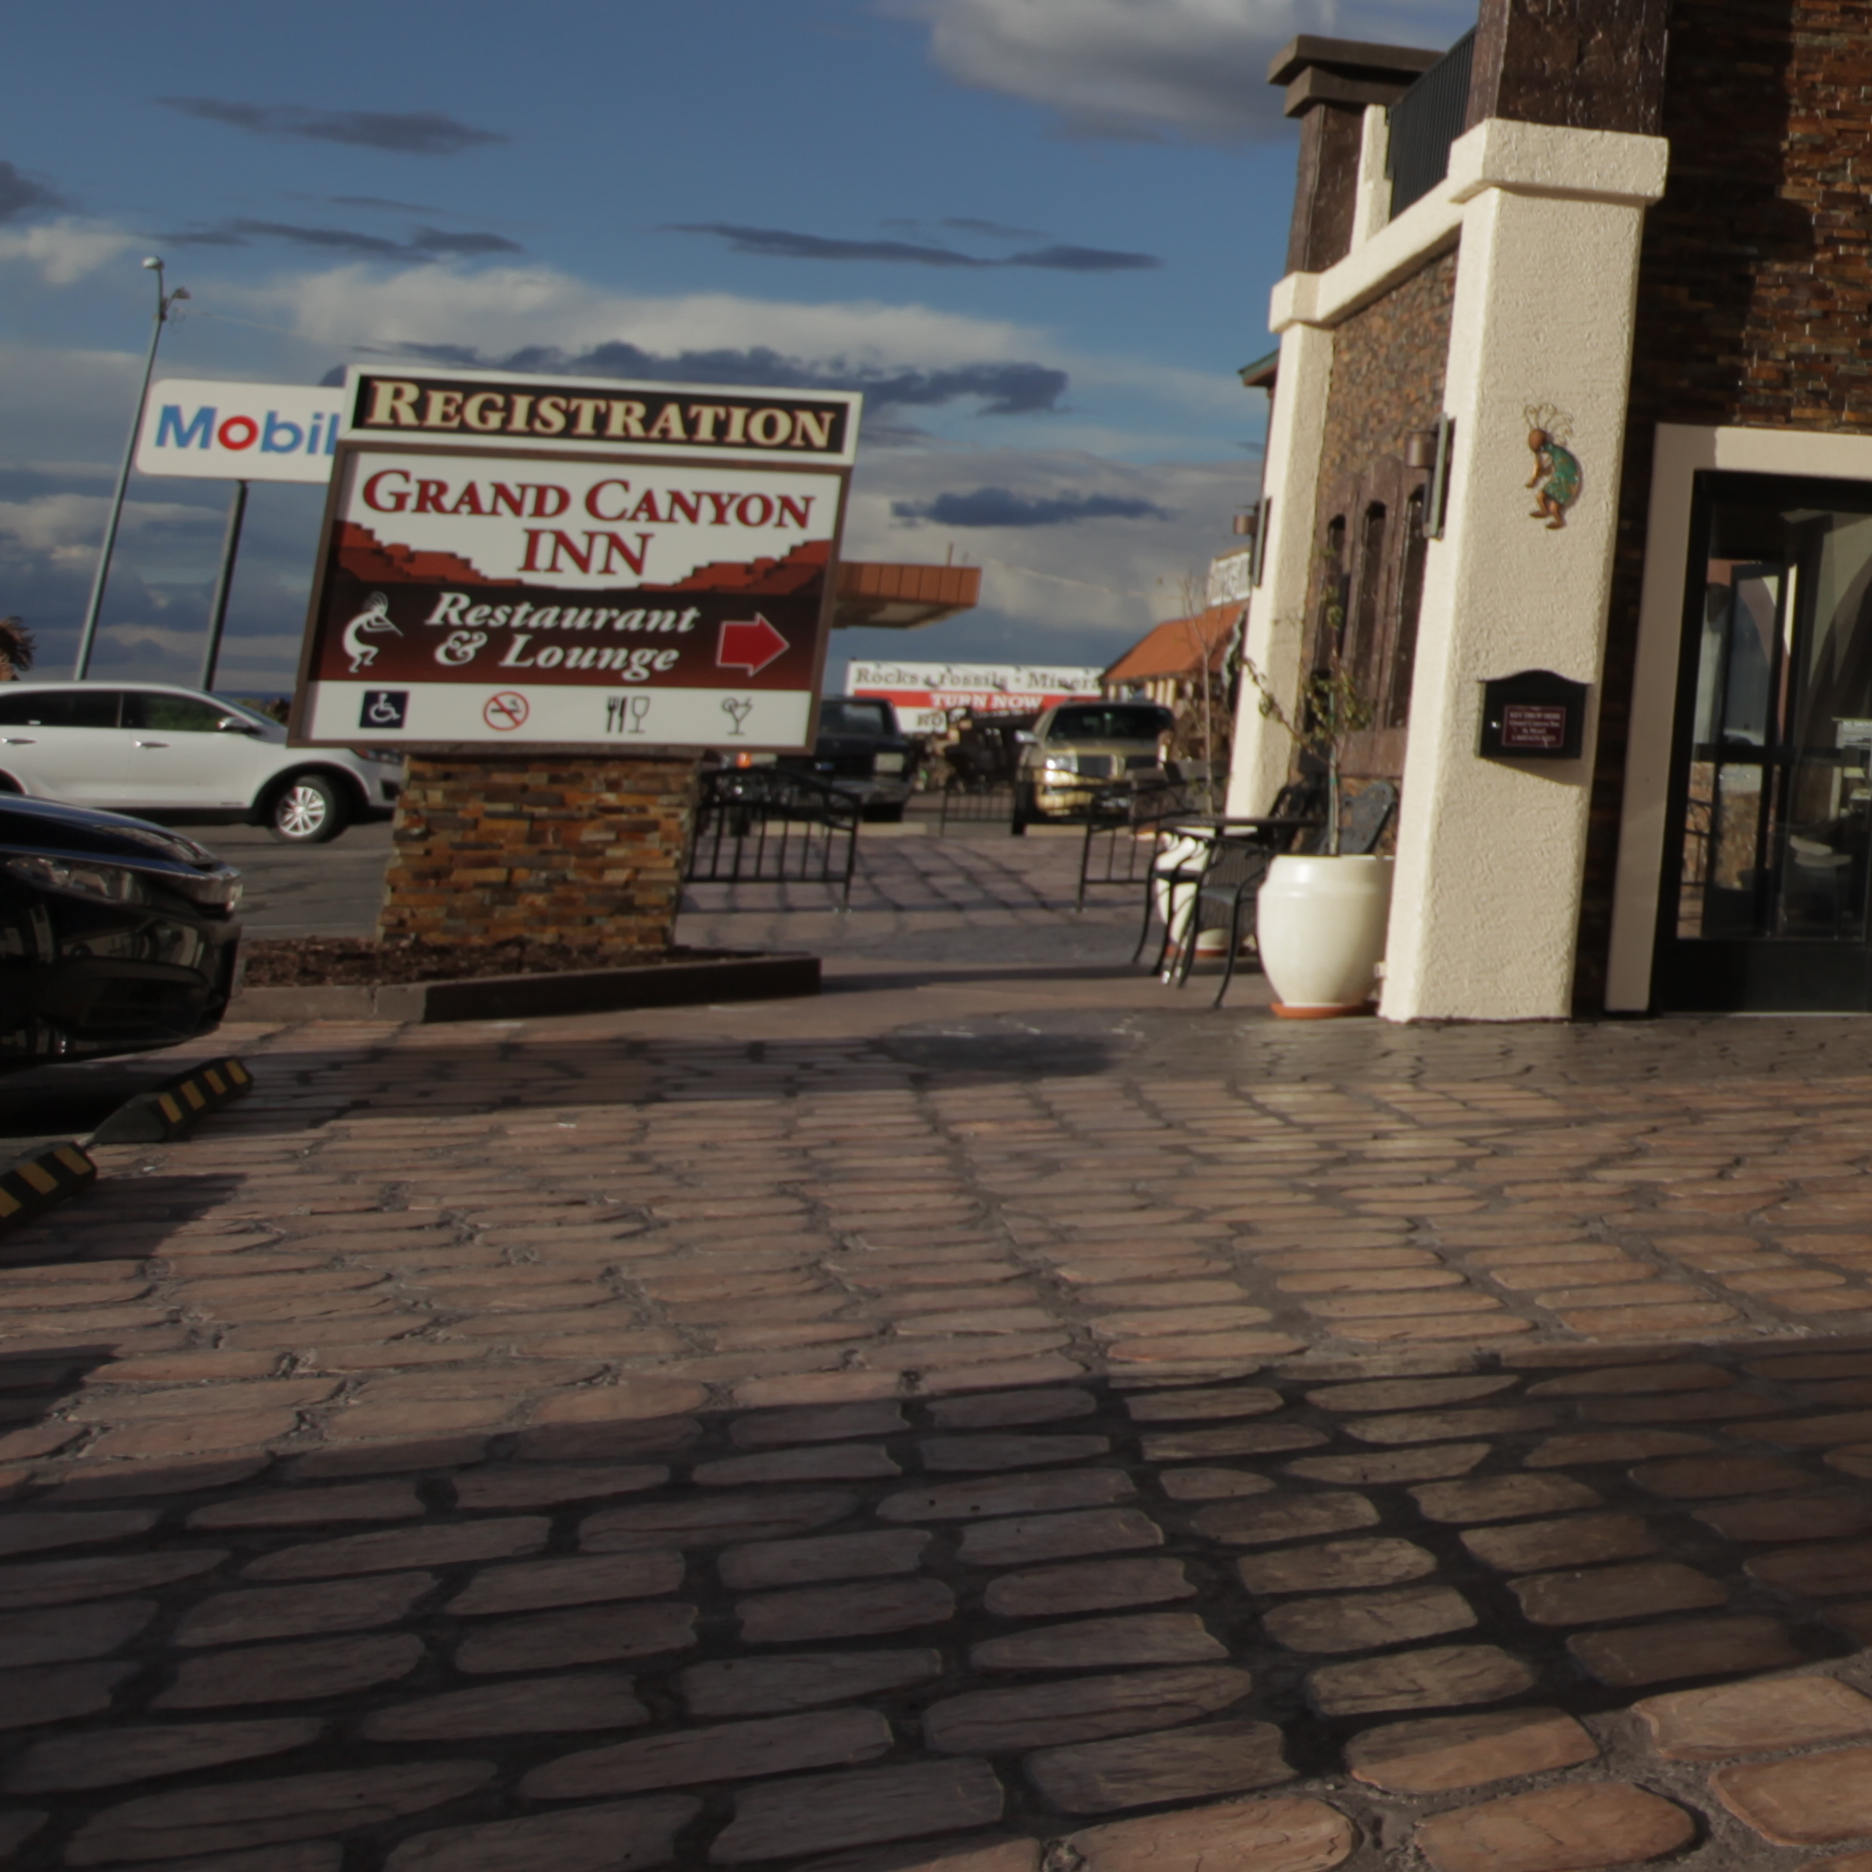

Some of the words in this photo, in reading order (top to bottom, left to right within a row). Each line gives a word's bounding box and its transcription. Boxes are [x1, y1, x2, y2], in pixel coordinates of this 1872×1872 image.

[155, 404, 341, 455] Mobil
[366, 380, 836, 449] REGISTRATION
[362, 468, 571, 518] GRAND
[585, 479, 816, 529] CANYON
[517, 528, 655, 576] INN
[424, 592, 700, 632] Restaurant
[434, 630, 488, 665] &
[498, 633, 680, 682] Lounge
[856, 667, 918, 685] Rocks
[930, 692, 988, 710] TURN
[991, 694, 1043, 711] NOW
